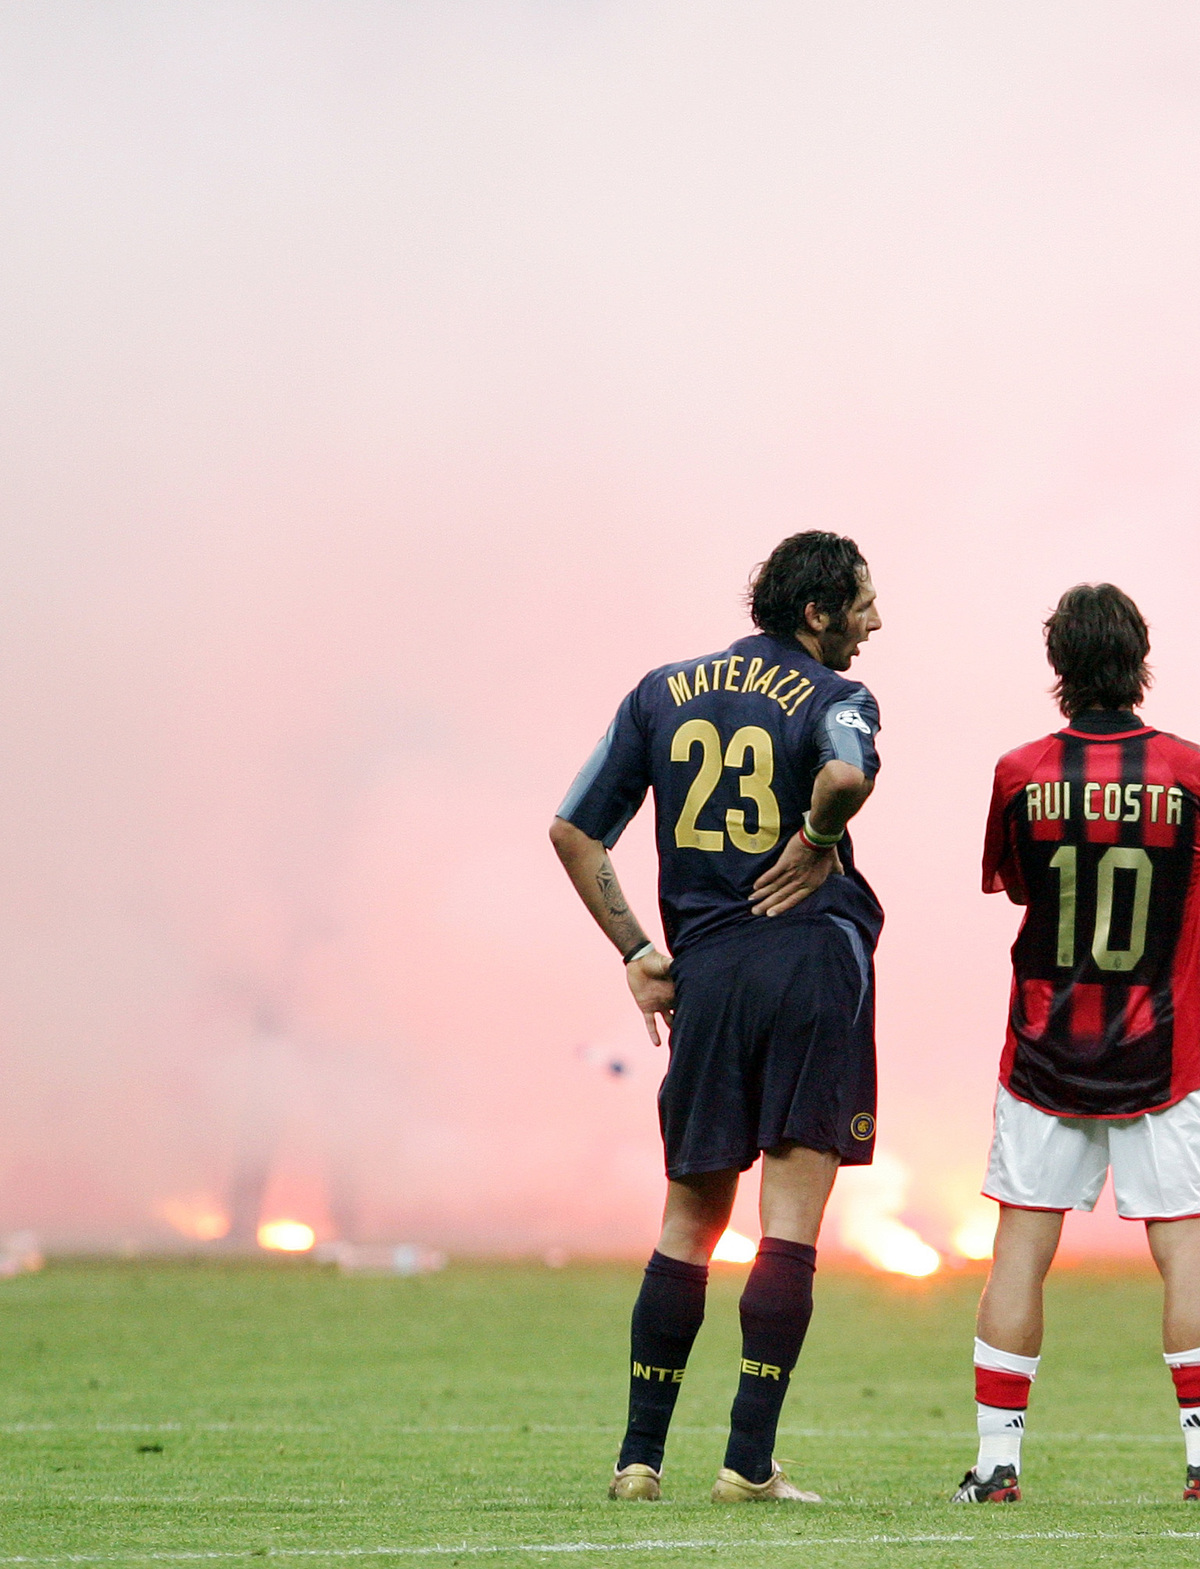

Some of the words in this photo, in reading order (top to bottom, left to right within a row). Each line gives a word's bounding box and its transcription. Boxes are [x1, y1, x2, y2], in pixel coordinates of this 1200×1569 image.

[667, 655, 815, 717] MATERAZZI
[670, 718, 780, 853] 23
[1025, 781, 1071, 821] RUI
[1083, 782, 1183, 825] COSTA
[1049, 845, 1153, 971] 10
